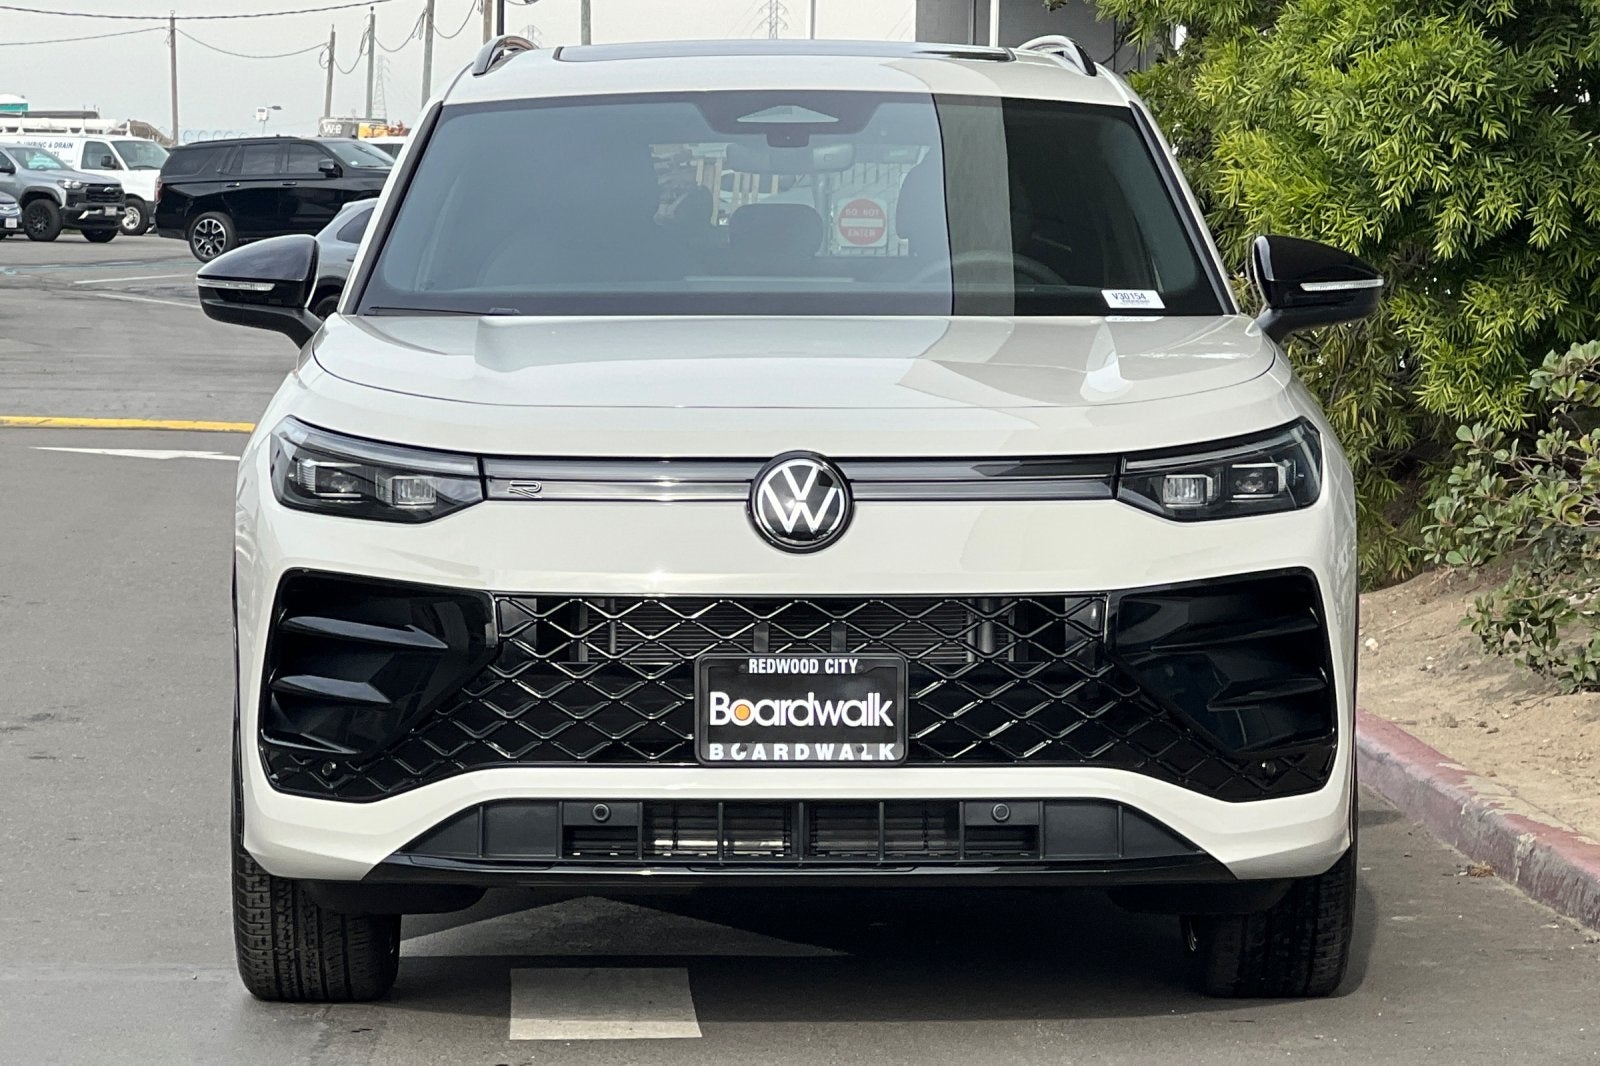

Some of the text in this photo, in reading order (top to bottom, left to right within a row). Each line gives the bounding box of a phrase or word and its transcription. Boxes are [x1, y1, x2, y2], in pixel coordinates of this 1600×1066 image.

[54, 141, 74, 149] DRAIN
[845, 208, 879, 217] DO NOT
[1111, 292, 1147, 301] V30154
[748, 658, 858, 674] REDWOOD CITY
[709, 691, 894, 727] Boardwalk
[709, 743, 895, 761] BOARDWALK
